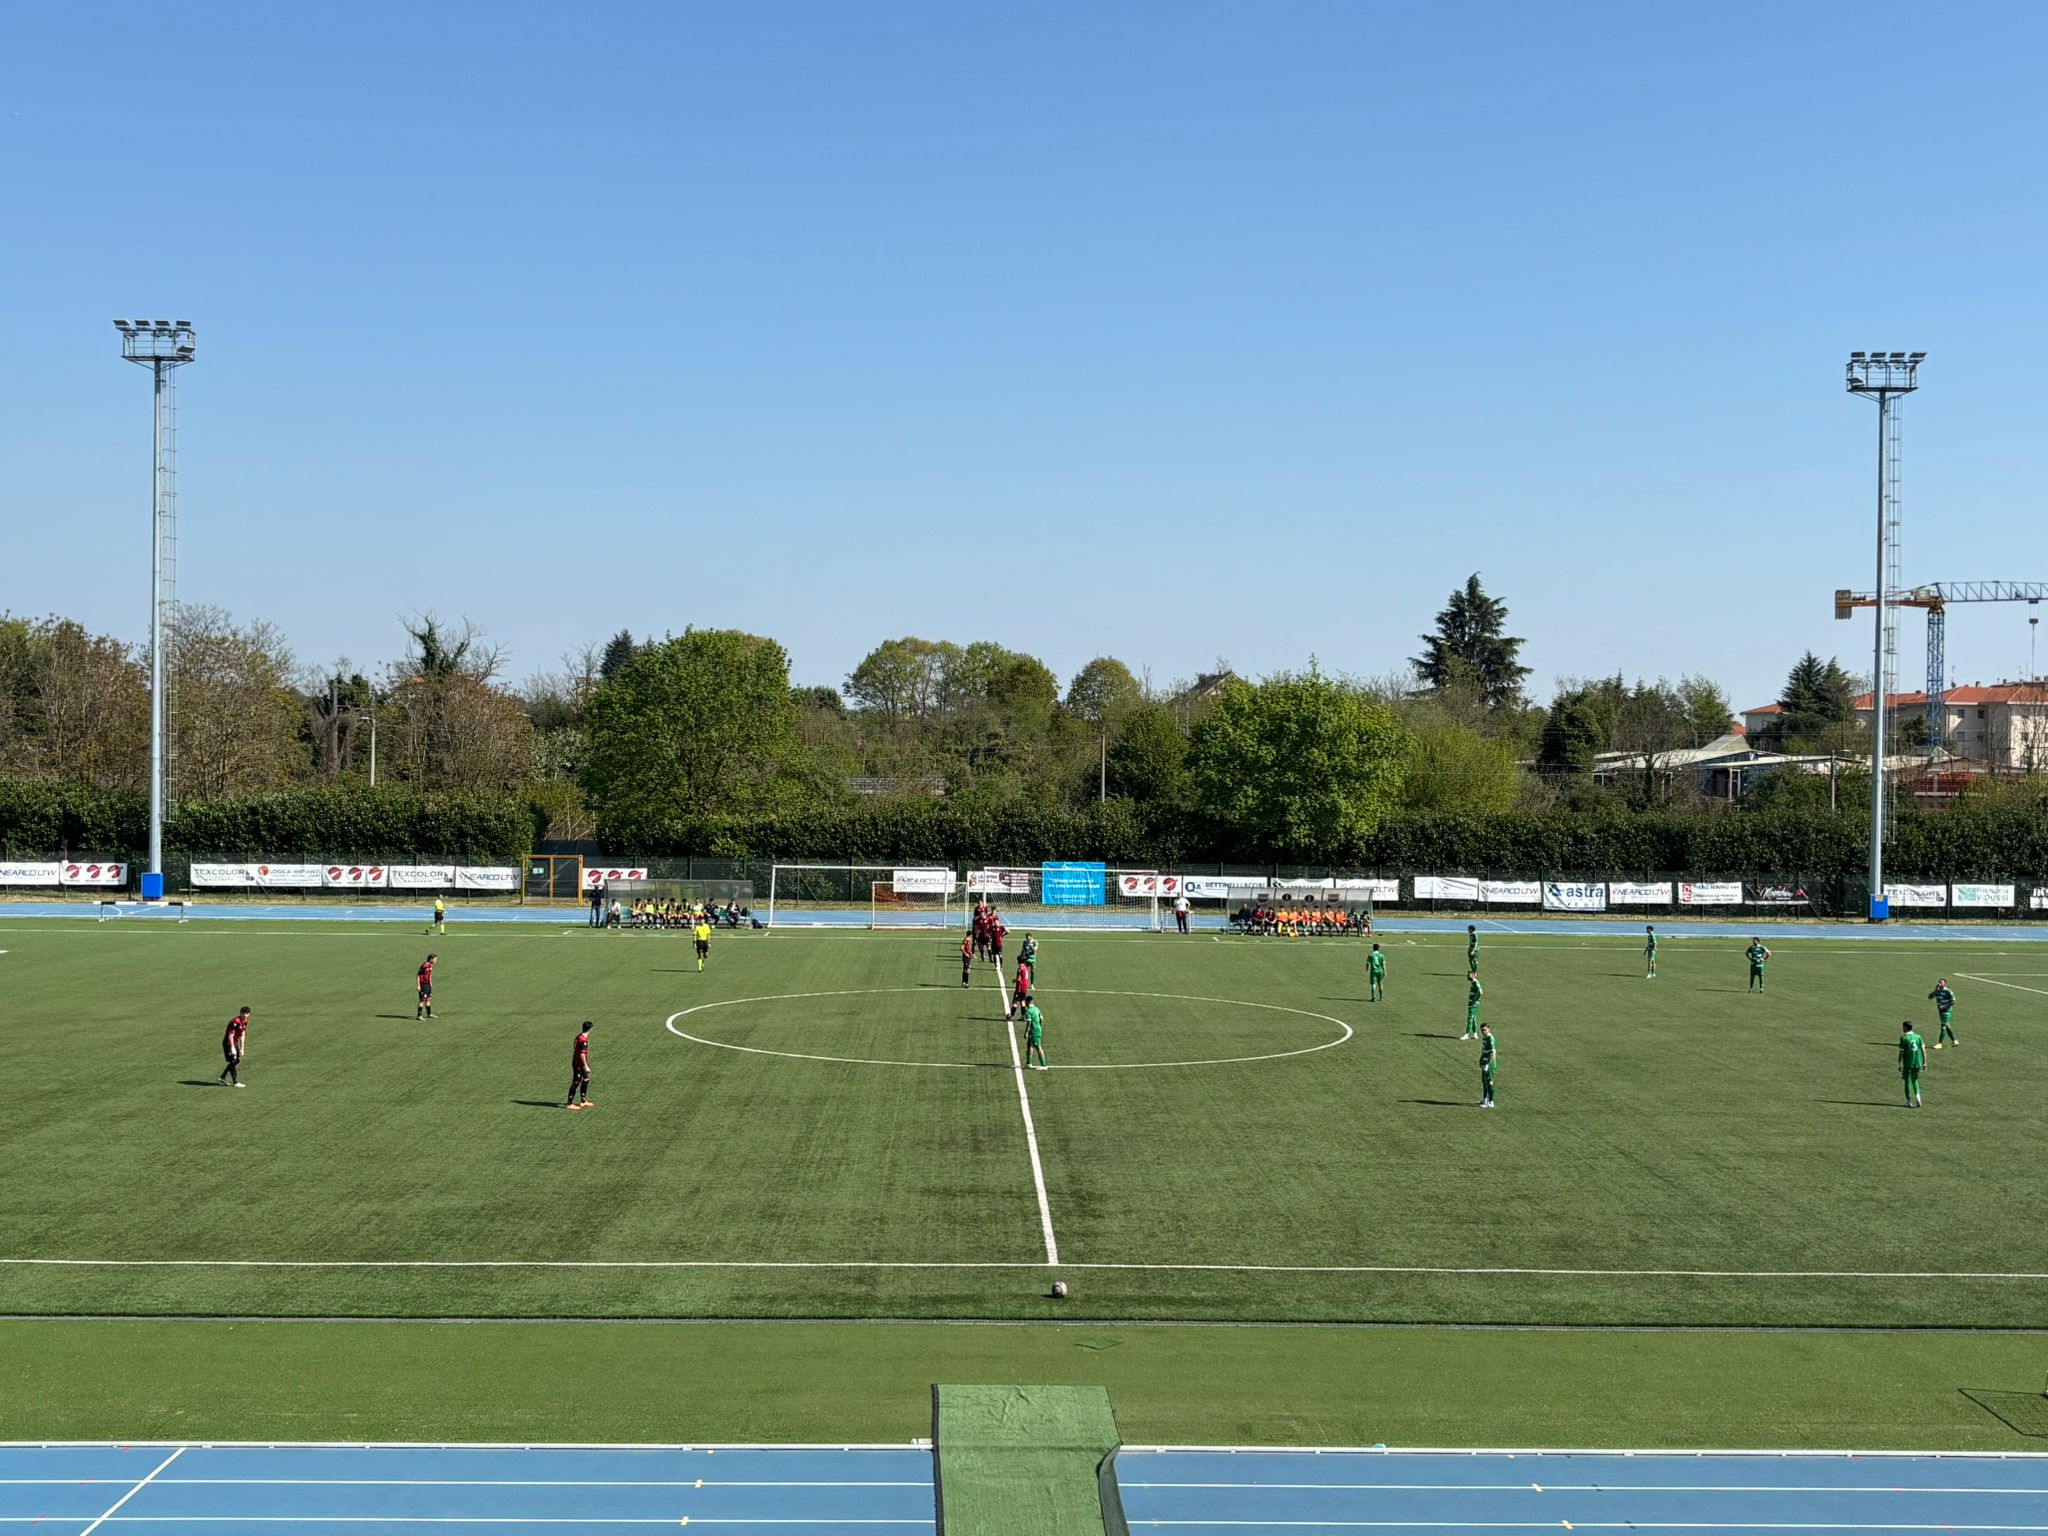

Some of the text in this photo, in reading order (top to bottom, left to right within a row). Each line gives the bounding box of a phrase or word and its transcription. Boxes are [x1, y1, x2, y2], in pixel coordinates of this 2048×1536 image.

[391, 870, 444, 878] TEXCOLOR
[1566, 885, 1604, 898] astra
[1910, 1038, 1919, 1052] 3
